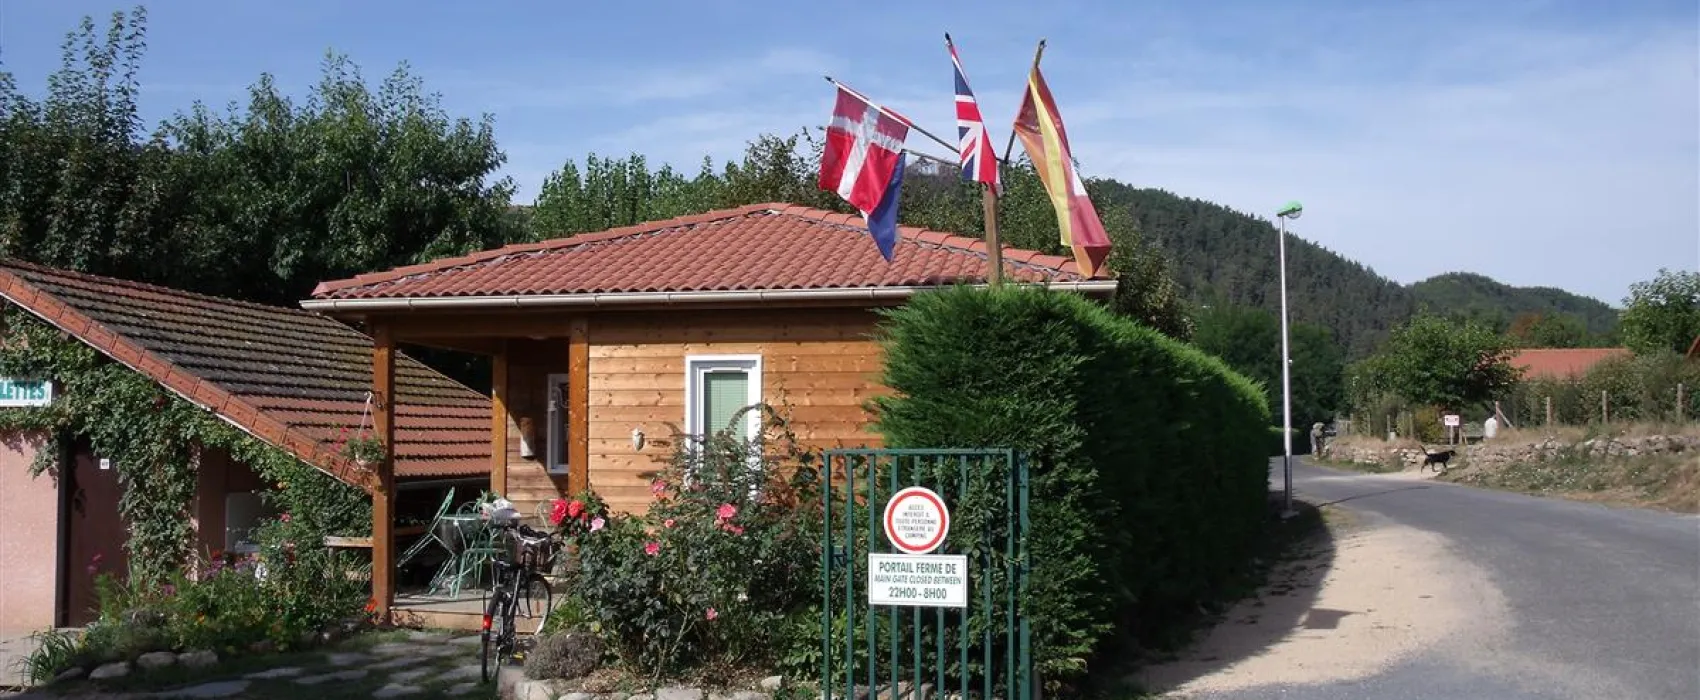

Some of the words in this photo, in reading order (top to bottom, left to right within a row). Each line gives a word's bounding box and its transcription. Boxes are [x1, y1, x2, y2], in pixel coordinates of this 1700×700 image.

[879, 561, 914, 573] PORTAIL
[916, 562, 943, 574] FERME
[945, 563, 957, 574] DE
[874, 574, 891, 582] MAIN
[893, 575, 908, 583] GATE
[910, 575, 932, 584] CLOSED
[934, 576, 962, 584] BETWEEN
[888, 586, 917, 598] 22H00
[923, 587, 947, 599] 8H00
